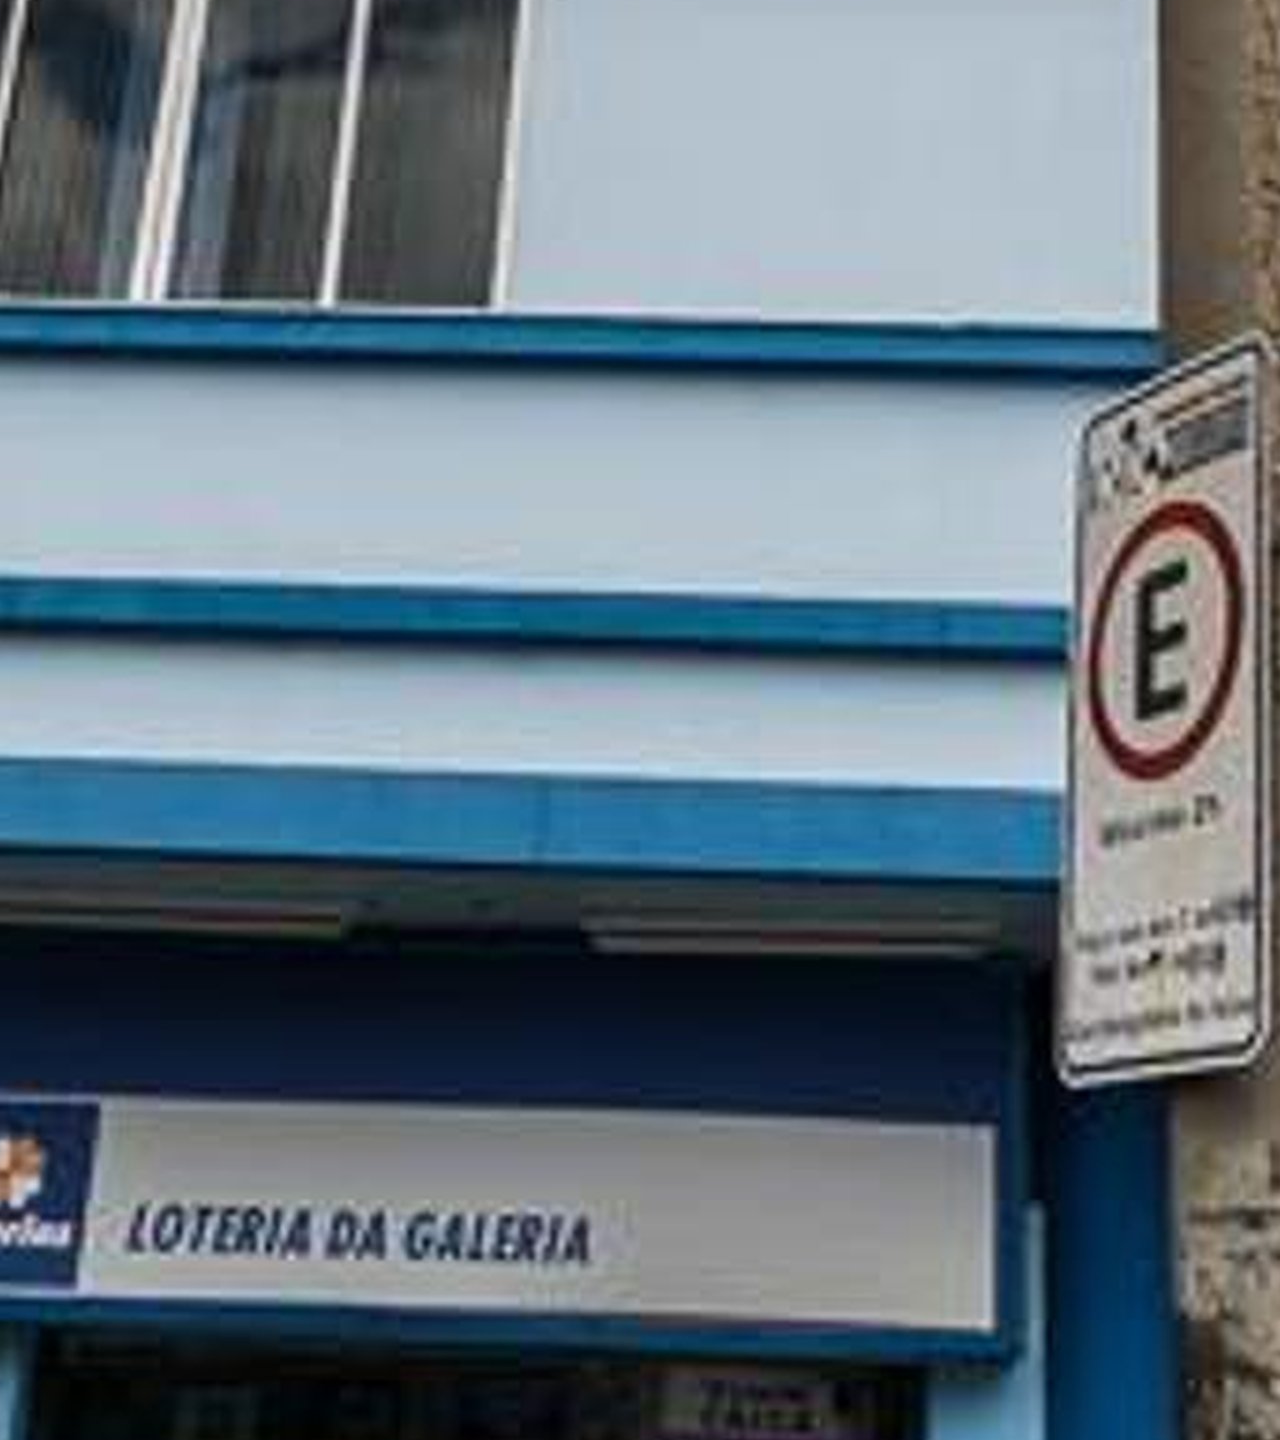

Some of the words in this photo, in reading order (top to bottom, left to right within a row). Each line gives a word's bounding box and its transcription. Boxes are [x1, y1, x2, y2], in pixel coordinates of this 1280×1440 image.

[1132, 559, 1190, 722] E
[126, 1201, 313, 1258] LOTERIA
[322, 1208, 390, 1261] DA
[405, 1211, 594, 1267] GALERIA
